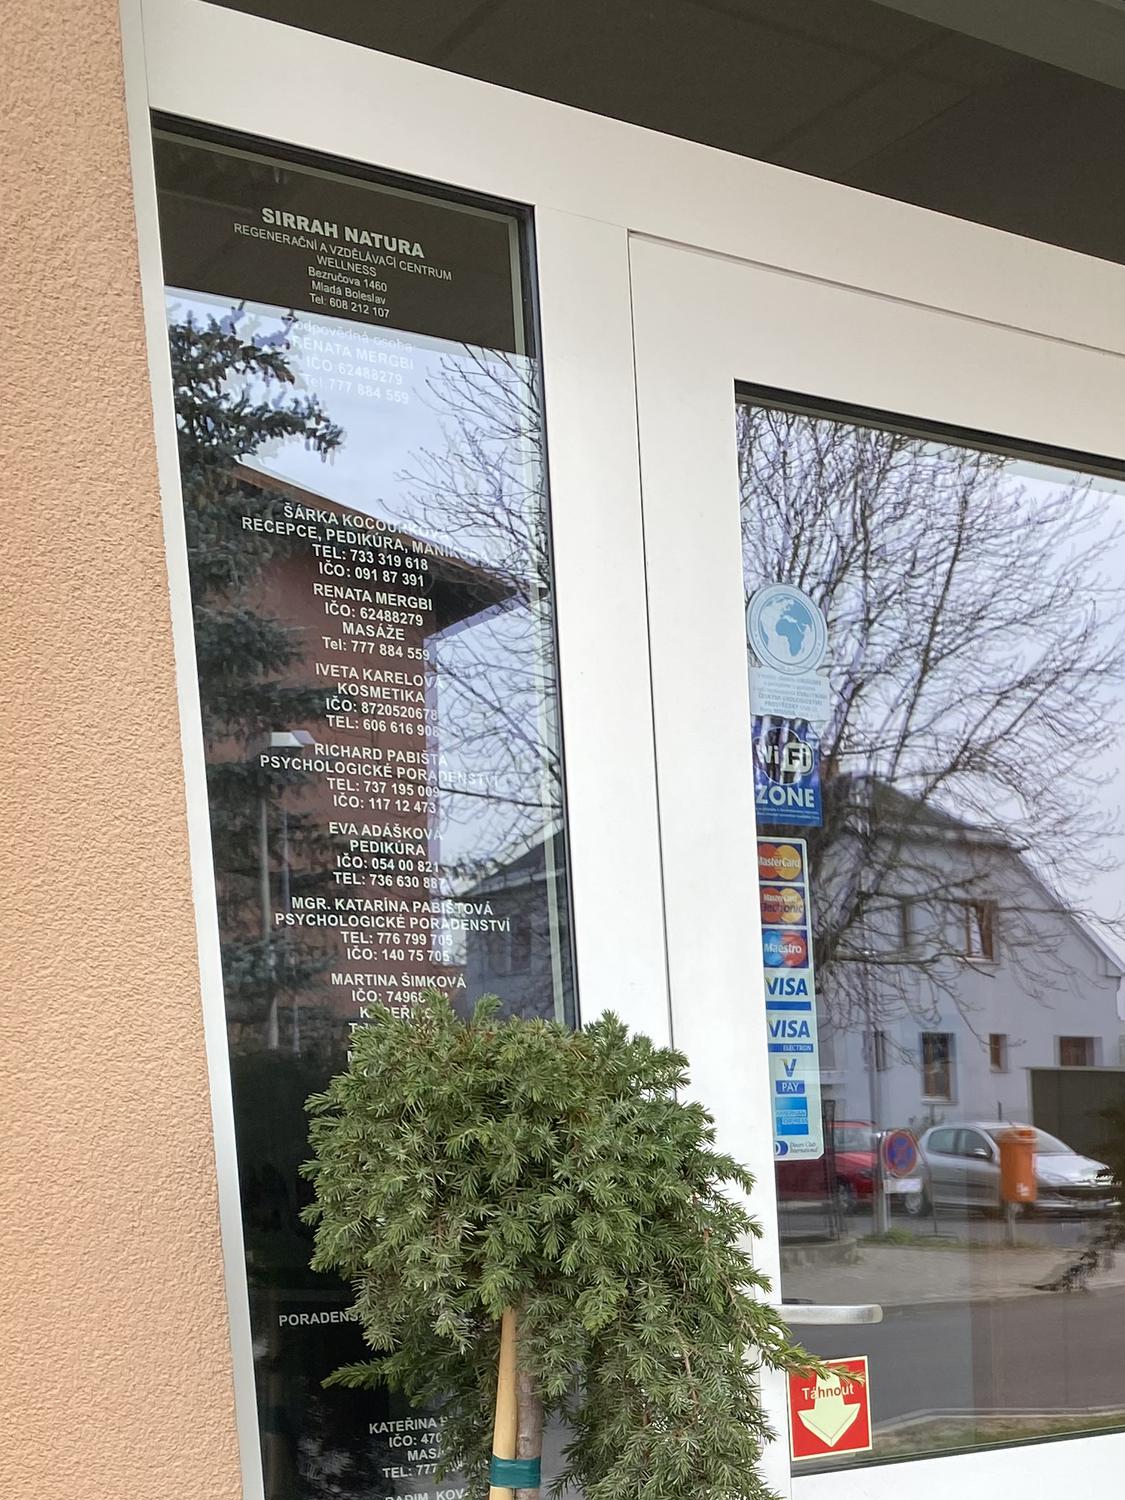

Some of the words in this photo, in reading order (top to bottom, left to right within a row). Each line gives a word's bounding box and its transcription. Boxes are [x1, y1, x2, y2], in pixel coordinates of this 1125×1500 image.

[262, 208, 338, 239] SIRRAH
[344, 227, 424, 258] NATURA
[234, 223, 317, 250] REGENERAČNÍ
[320, 243, 327, 252] A
[399, 260, 452, 281] CENTRUM
[317, 255, 376, 277] WELLNESS
[308, 267, 360, 287] Bezručova
[364, 279, 387, 292] 1460
[312, 280, 342, 296] Mladá
[345, 288, 386, 305] Boleslav
[329, 297, 348, 310] 608
[351, 302, 369, 314] 212
[372, 306, 390, 318] 107
[356, 348, 414, 370] MERGBI
[283, 502, 339, 526] ŠÁRKA
[241, 517, 322, 542] RECEPCE,
[326, 529, 409, 554] PEDIKÚRA,
[312, 544, 346, 560] TEL:
[351, 549, 374, 564] 733
[378, 553, 401, 567] 319
[405, 556, 428, 571] 618
[319, 561, 350, 578] IČO:
[354, 566, 377, 582] 091
[382, 570, 398, 584] 87
[402, 573, 424, 588] 391
[313, 583, 373, 603] RENATA
[375, 591, 433, 611] MERGBI
[325, 601, 356, 618] IČO:
[359, 607, 424, 626] 62488279
[342, 621, 405, 641] MASÁŽE
[322, 636, 347, 652] Tel:
[351, 640, 375, 654] 777
[379, 644, 403, 657] 884
[407, 647, 431, 661] 559
[315, 662, 359, 680] IVETA
[337, 682, 425, 703] KOSMETIKA
[326, 696, 357, 712] IČO:
[361, 703, 438, 721] 8720520678
[326, 714, 360, 730] TEL:
[363, 718, 386, 732] 606
[390, 721, 413, 735] 616
[314, 743, 383, 761] RICHARD
[387, 747, 448, 766] PABIŠTA
[260, 754, 392, 779] PSYCHOLOGICKÉ
[327, 777, 360, 792] TEL:
[363, 780, 386, 794] 737
[391, 782, 414, 796] 195
[417, 784, 440, 798] 009
[755, 785, 815, 808] ZONE
[333, 793, 364, 809] IČO:
[368, 798, 391, 812] 117
[395, 800, 411, 812] 12
[413, 801, 436, 814] 473
[329, 822, 358, 836] EVA
[350, 838, 426, 857] PEDIKÚRA
[336, 854, 368, 870] IČO:
[371, 857, 395, 871] 054
[399, 859, 414, 872] 00
[417, 860, 439, 873] 821
[333, 872, 365, 885] TEL:
[369, 874, 393, 887] 736
[396, 875, 419, 888] 630
[291, 897, 331, 911] MGR.
[335, 896, 409, 913] KATARÍNA
[413, 898, 494, 915] PABIŠTOVÁ
[275, 913, 405, 929] PSYCHOLOGICKÉ
[410, 917, 511, 932] PORADENSTVÍ
[340, 932, 373, 944] TEL:
[377, 932, 400, 945] 776
[403, 933, 427, 946] 799
[430, 933, 453, 946] 705
[764, 943, 802, 955] Maestro
[347, 948, 377, 961] IČO:
[381, 950, 405, 961] 140
[408, 950, 423, 961] 75
[426, 950, 450, 962] 705
[331, 973, 398, 986] MARTINA
[401, 972, 467, 988] ŠIMKOVÁ
[765, 976, 808, 996] VISA
[352, 988, 382, 1002] IČO:
[767, 1020, 810, 1038] VISA
[783, 1058, 797, 1077] V
[782, 1082, 799, 1092] PAY
[802, 1384, 854, 1400] Táhnout
[369, 1417, 438, 1434] KATEŘINA
[388, 1433, 417, 1448] IČO:
[382, 1467, 412, 1478] TEL:
[416, 1463, 438, 1475] 777
